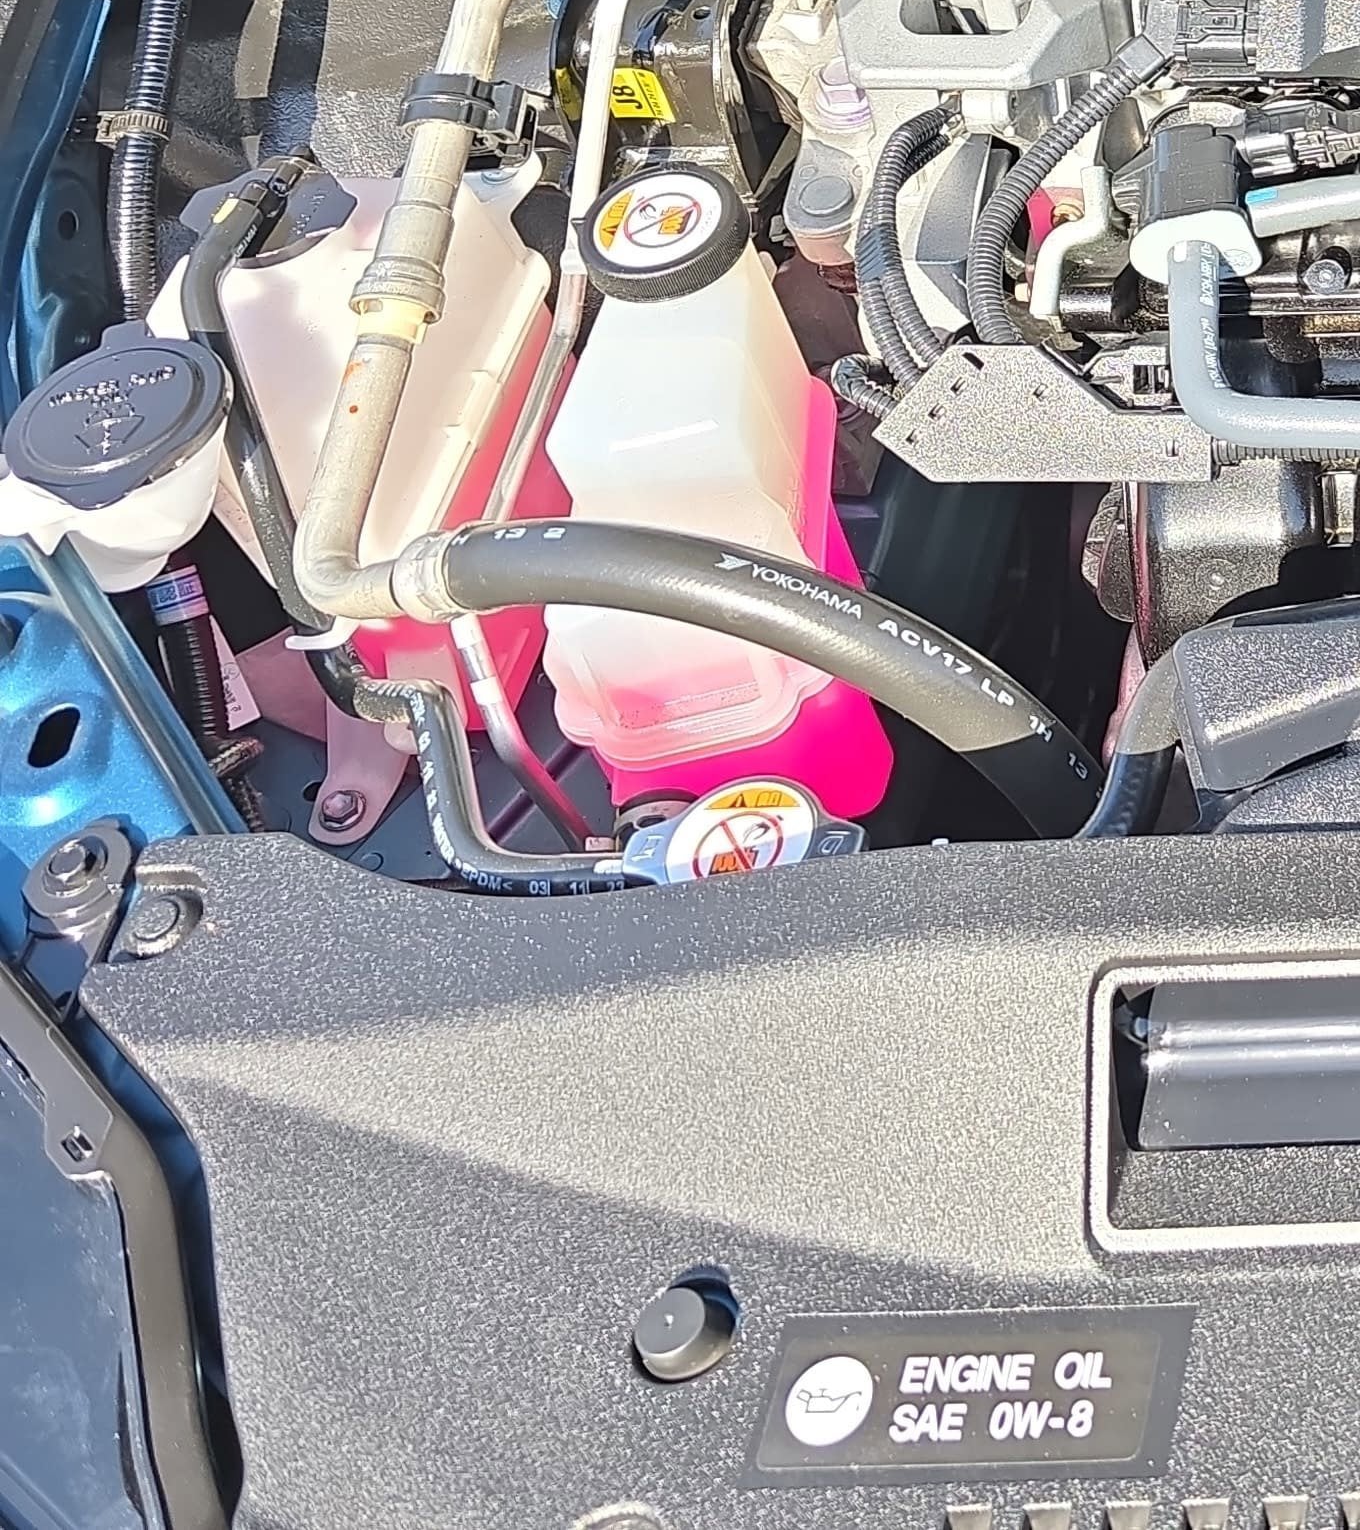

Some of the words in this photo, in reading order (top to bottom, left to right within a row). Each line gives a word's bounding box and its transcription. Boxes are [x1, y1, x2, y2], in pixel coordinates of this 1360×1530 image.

[751, 562, 863, 621] YOKOHAMA
[877, 618, 973, 676] ACV17
[979, 677, 1016, 708] LP
[899, 1353, 1036, 1394] ENGINE
[1053, 1351, 1113, 1390] OIL
[888, 1402, 968, 1443] SAE
[988, 1399, 1095, 1441] 0W-8
